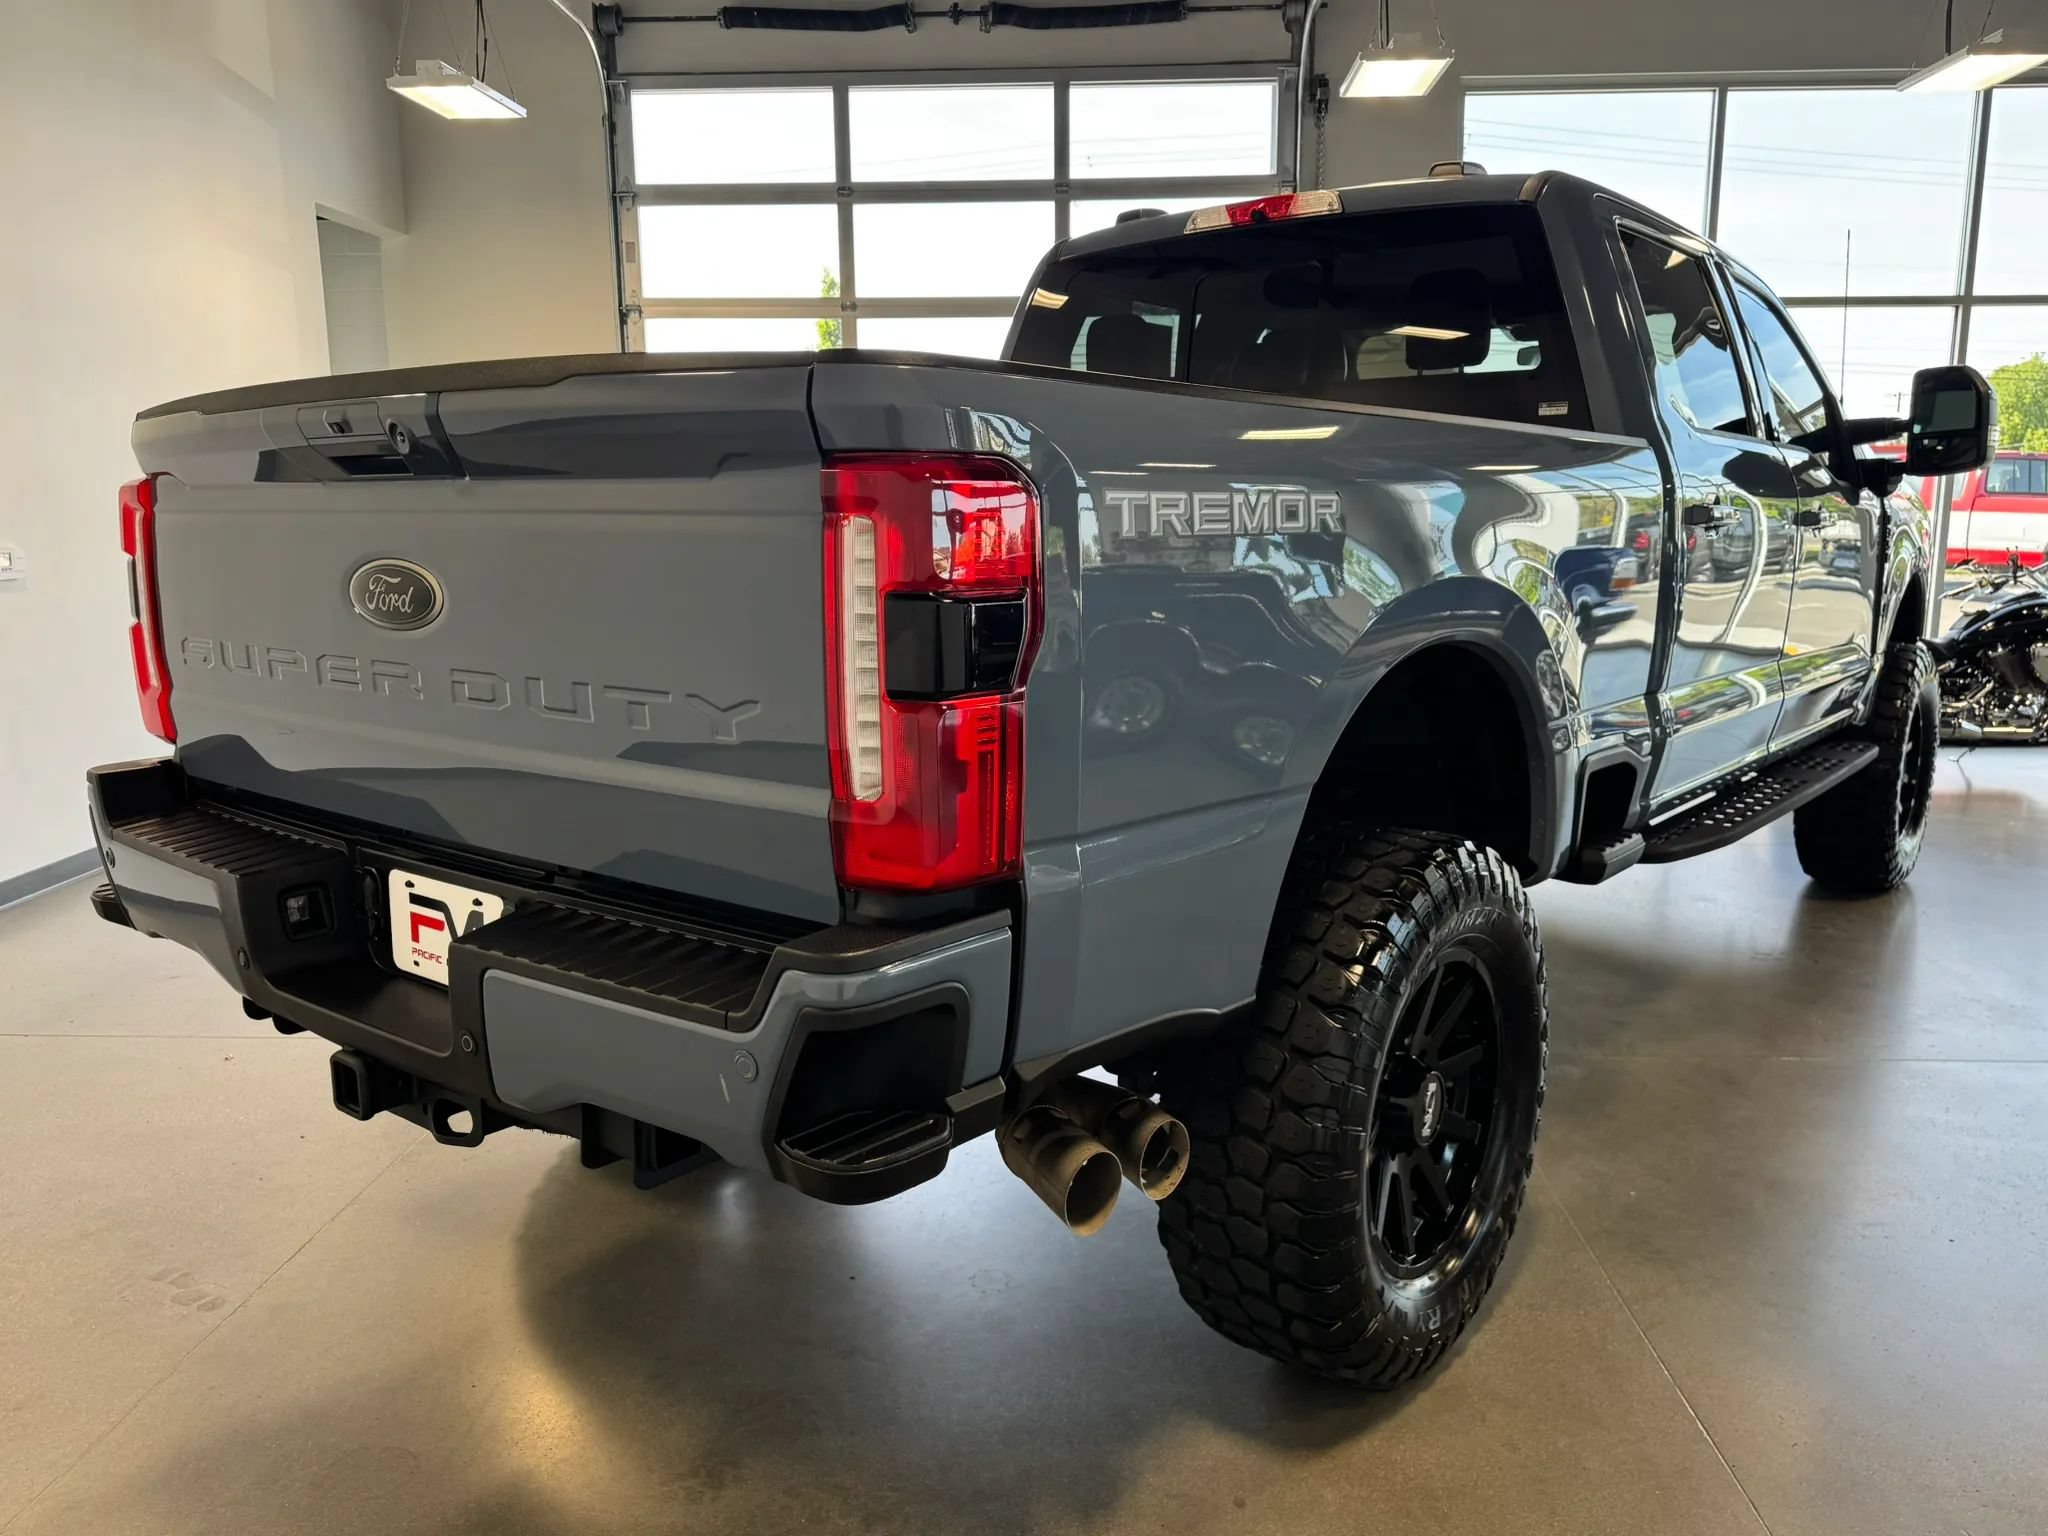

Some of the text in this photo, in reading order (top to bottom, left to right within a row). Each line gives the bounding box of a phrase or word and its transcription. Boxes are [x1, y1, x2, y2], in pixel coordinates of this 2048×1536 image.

[1104, 489, 1343, 537] TREMOR
[365, 573, 414, 613] Ford
[180, 636, 760, 742] SUPER DUTY
[411, 946, 443, 965] PACIFIC
